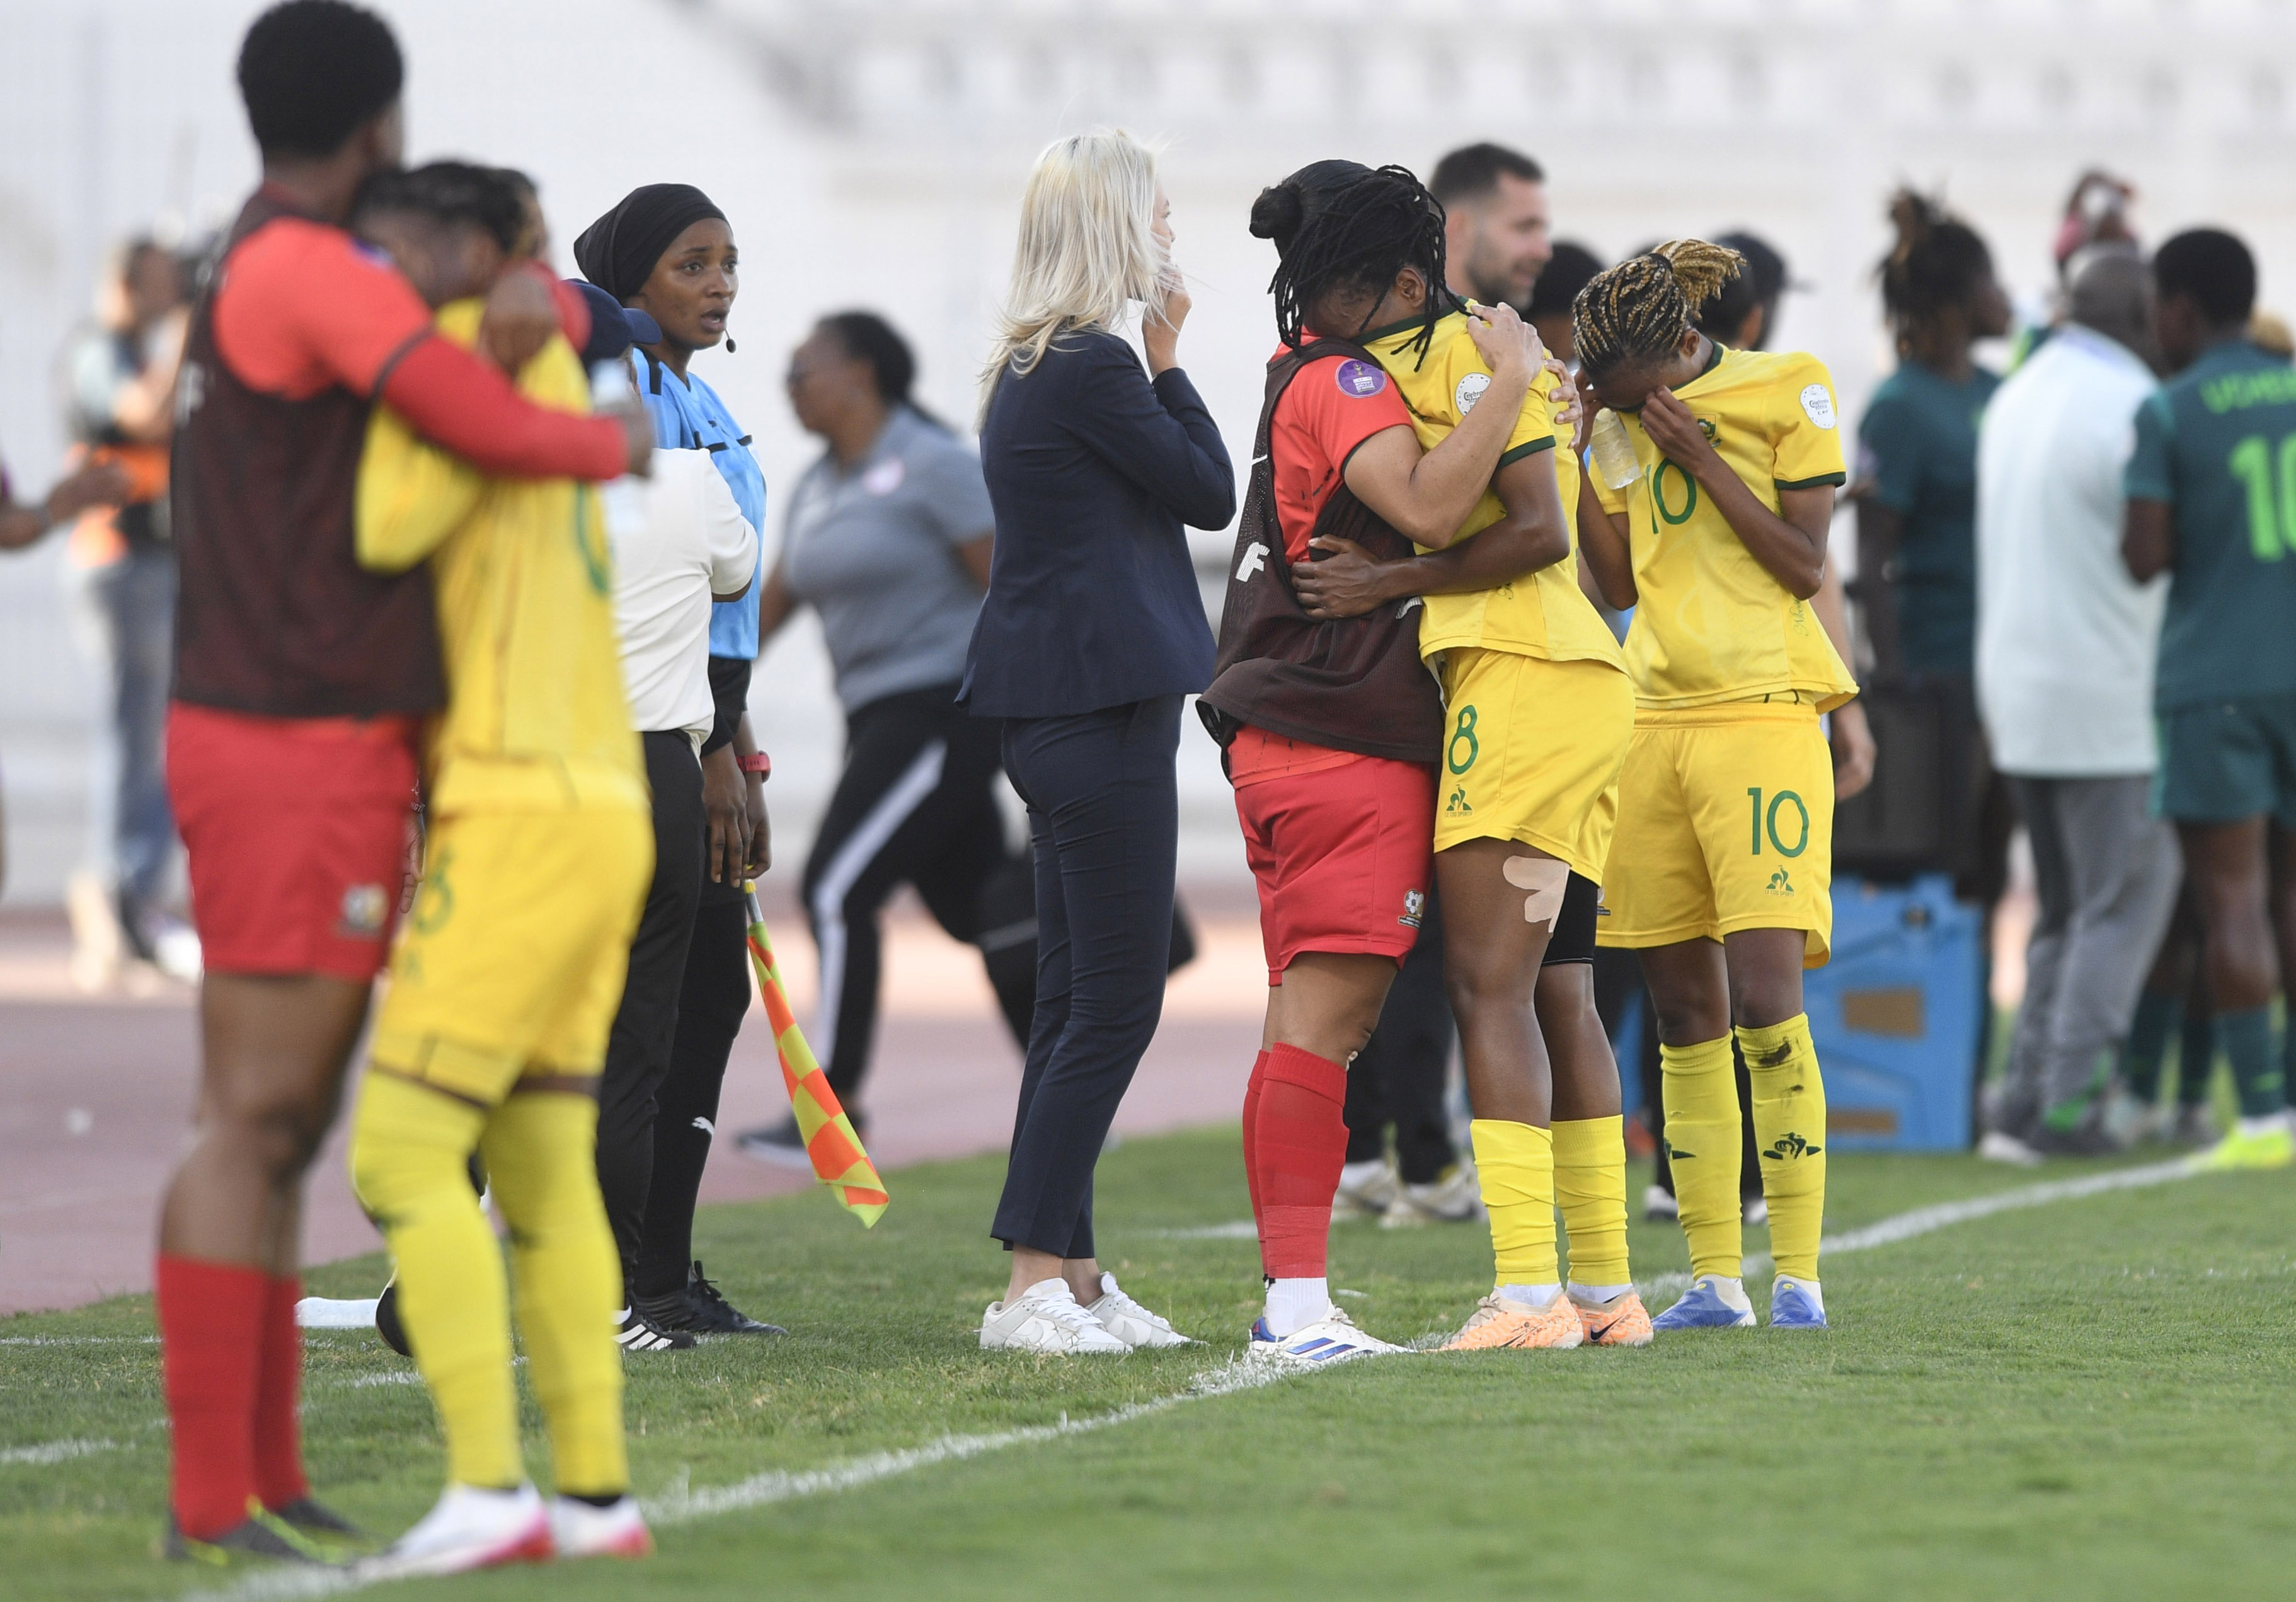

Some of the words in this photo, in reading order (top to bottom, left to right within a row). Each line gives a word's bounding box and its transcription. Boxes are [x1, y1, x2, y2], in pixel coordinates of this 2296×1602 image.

[1646, 458, 1697, 534] 10
[1236, 542, 1270, 582] F
[1449, 705, 1479, 775] 8
[1747, 787, 1809, 858] 10
